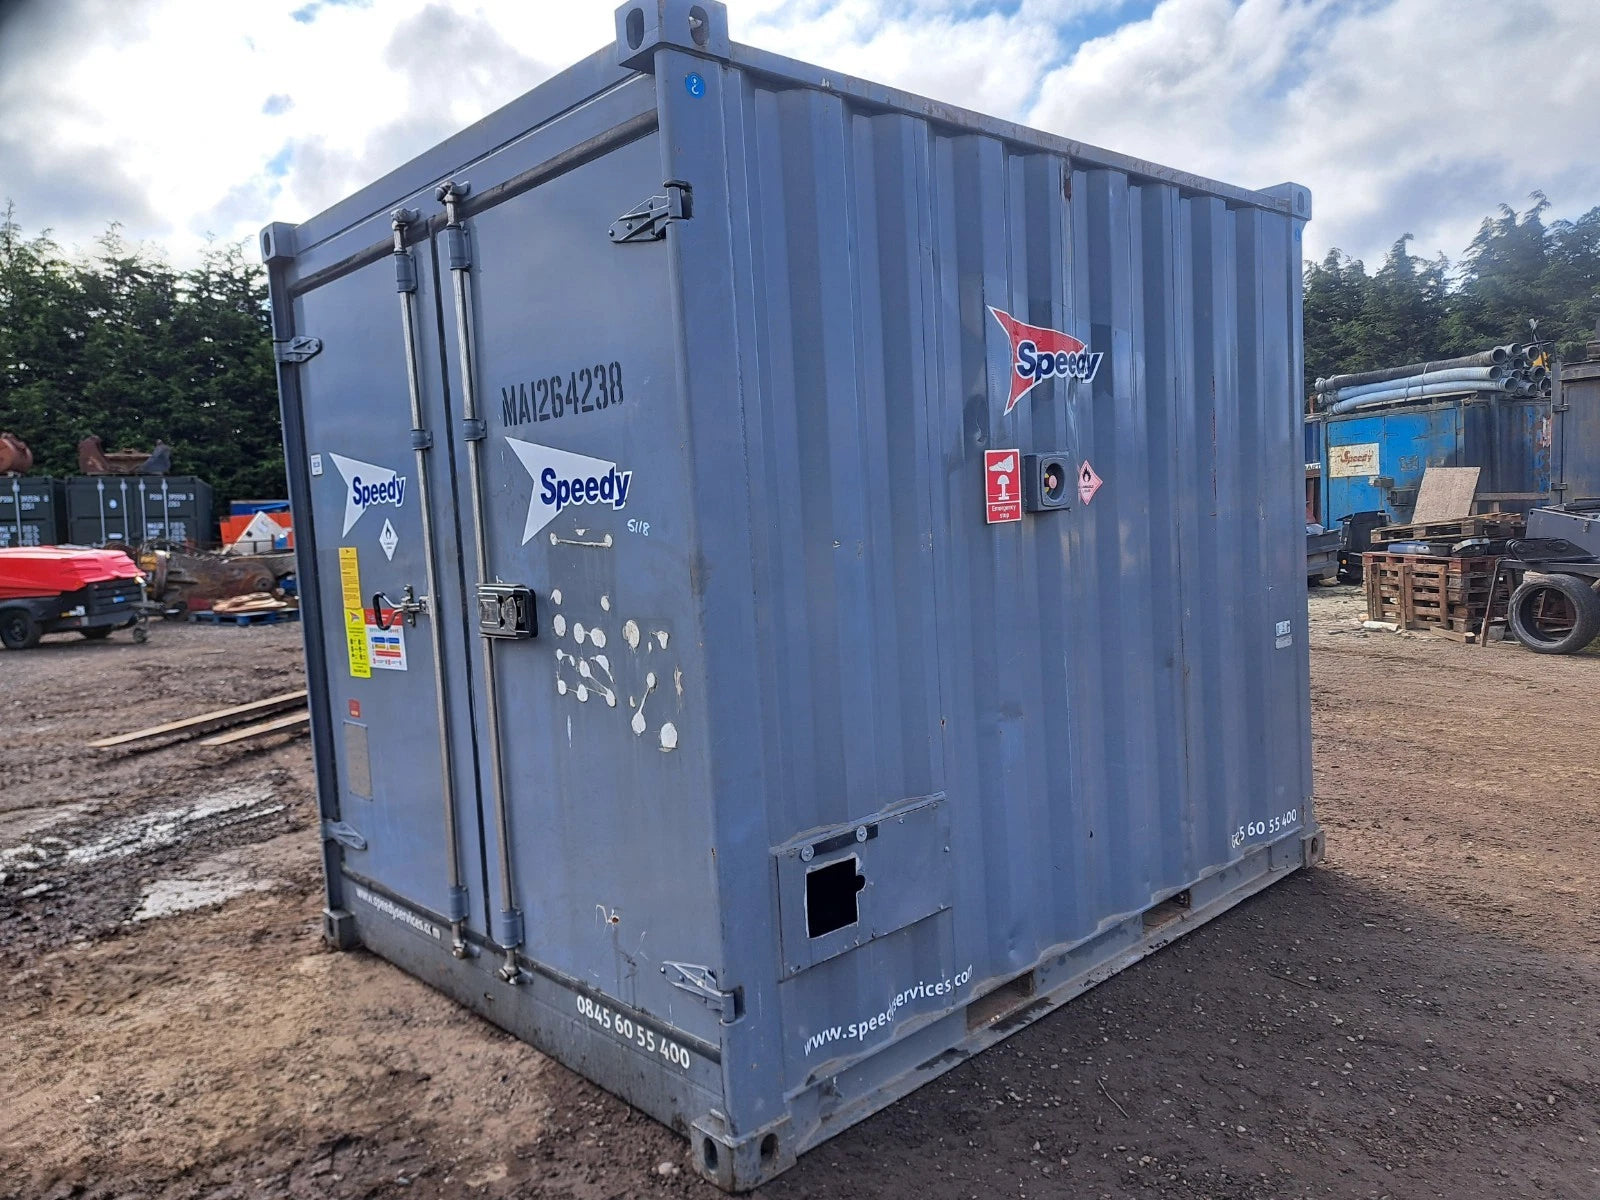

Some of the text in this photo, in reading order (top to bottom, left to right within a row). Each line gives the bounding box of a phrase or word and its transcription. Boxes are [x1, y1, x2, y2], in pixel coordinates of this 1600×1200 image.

[1017, 341, 1103, 382] Speedy
[352, 473, 405, 510] Speedy
[541, 467, 630, 511] Speedy
[1247, 821, 1265, 836] 60
[1269, 817, 1280, 833] 55
[1282, 809, 1296, 826] 400
[577, 995, 690, 1069] 0845 60 55 400
